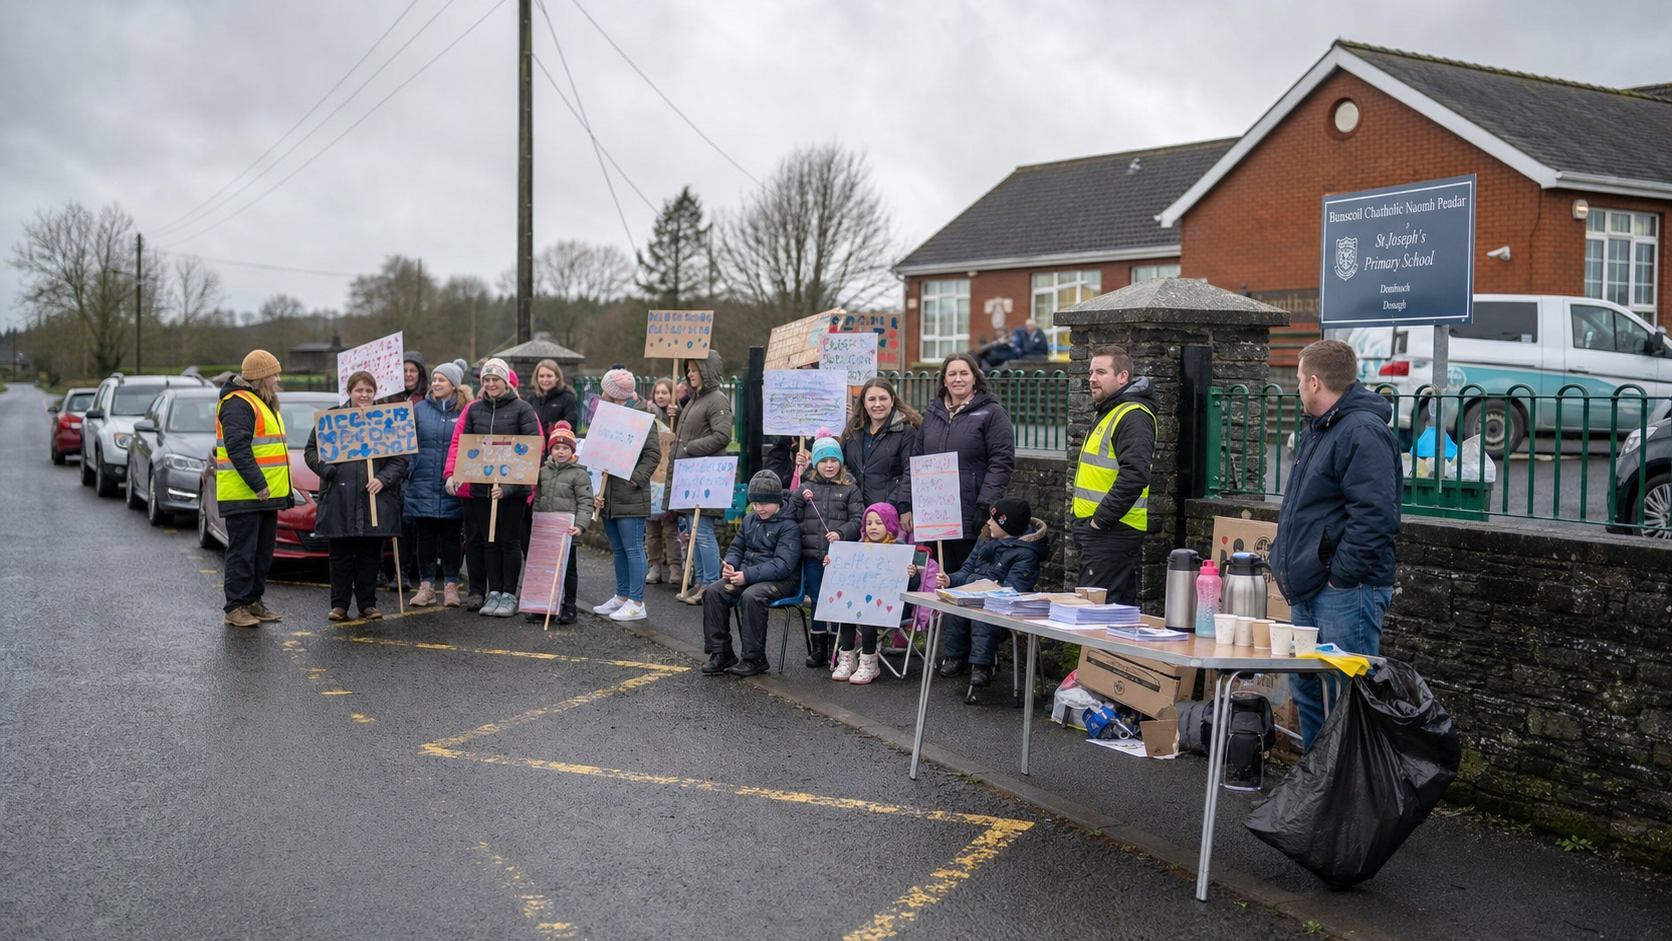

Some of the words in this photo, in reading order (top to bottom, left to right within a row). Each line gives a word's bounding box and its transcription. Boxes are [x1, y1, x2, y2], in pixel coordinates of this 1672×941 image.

[1329, 208, 1363, 223] Bunscoil
[1405, 198, 1435, 214] Naomh
[1437, 194, 1467, 209] Peadar
[1375, 233, 1386, 248] St
[1386, 228, 1427, 249] Joseph's
[1364, 256, 1401, 272] Primary
[1401, 250, 1436, 268] School
